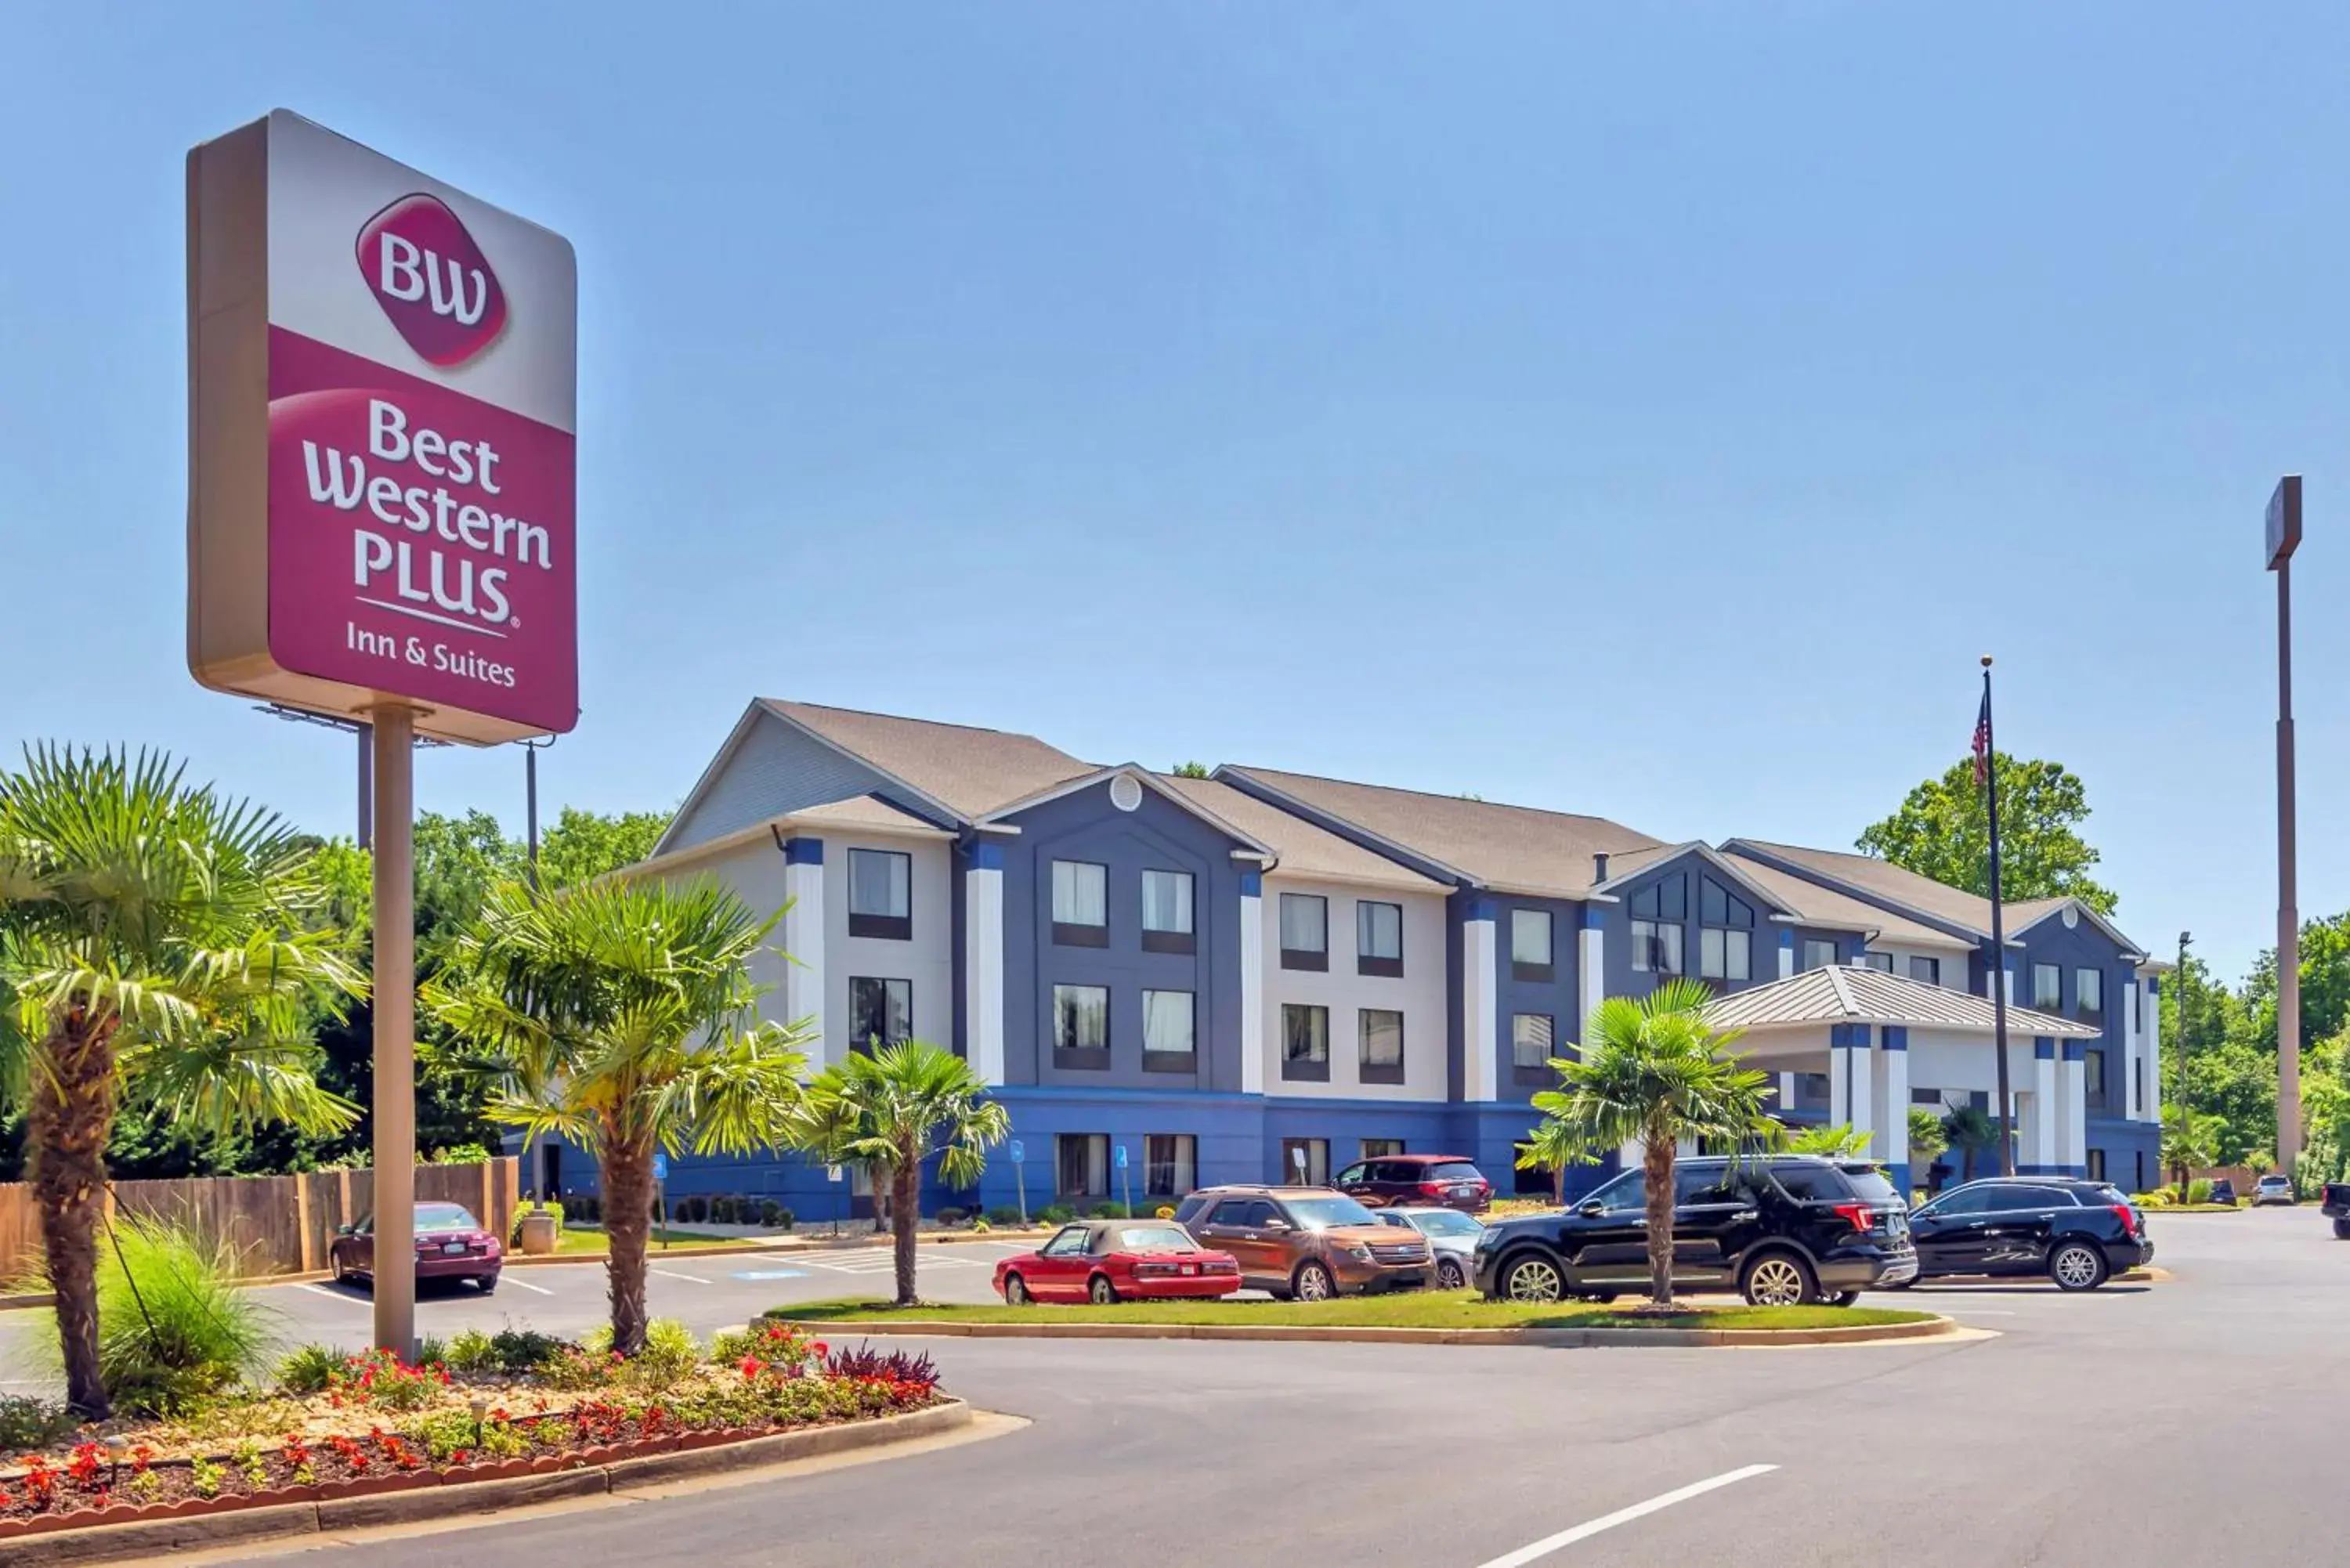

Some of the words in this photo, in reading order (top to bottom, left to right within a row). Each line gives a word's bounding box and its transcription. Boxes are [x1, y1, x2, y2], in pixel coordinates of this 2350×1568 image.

[381, 232, 486, 325] BW
[370, 398, 501, 495] Best
[302, 439, 552, 570] Western
[354, 528, 510, 623] PLUS
[346, 621, 397, 659] Inn
[404, 636, 428, 667] &
[433, 643, 516, 688] Suites
